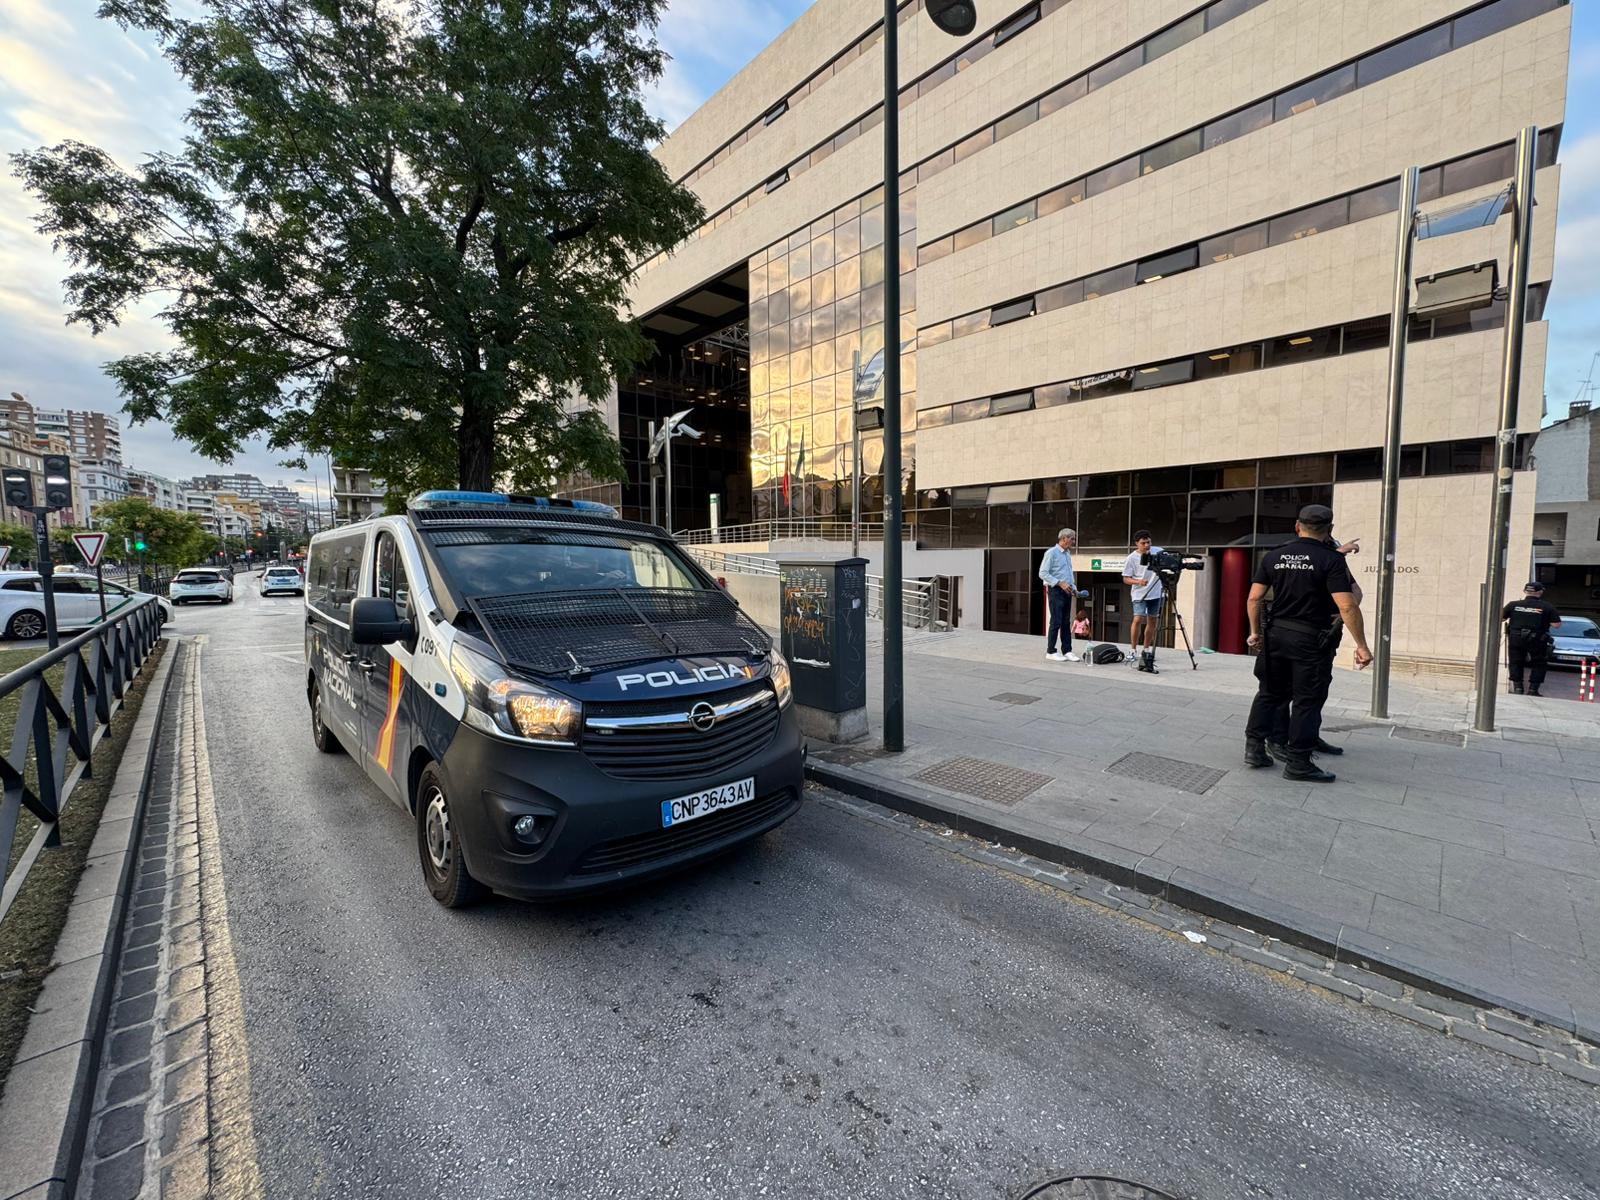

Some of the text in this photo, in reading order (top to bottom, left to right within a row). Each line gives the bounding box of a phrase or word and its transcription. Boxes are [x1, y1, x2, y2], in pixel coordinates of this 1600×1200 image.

[1273, 563, 1314, 571] GRANADA
[1363, 565, 1420, 574] JUDOS
[322, 666, 358, 710] NACIONAL
